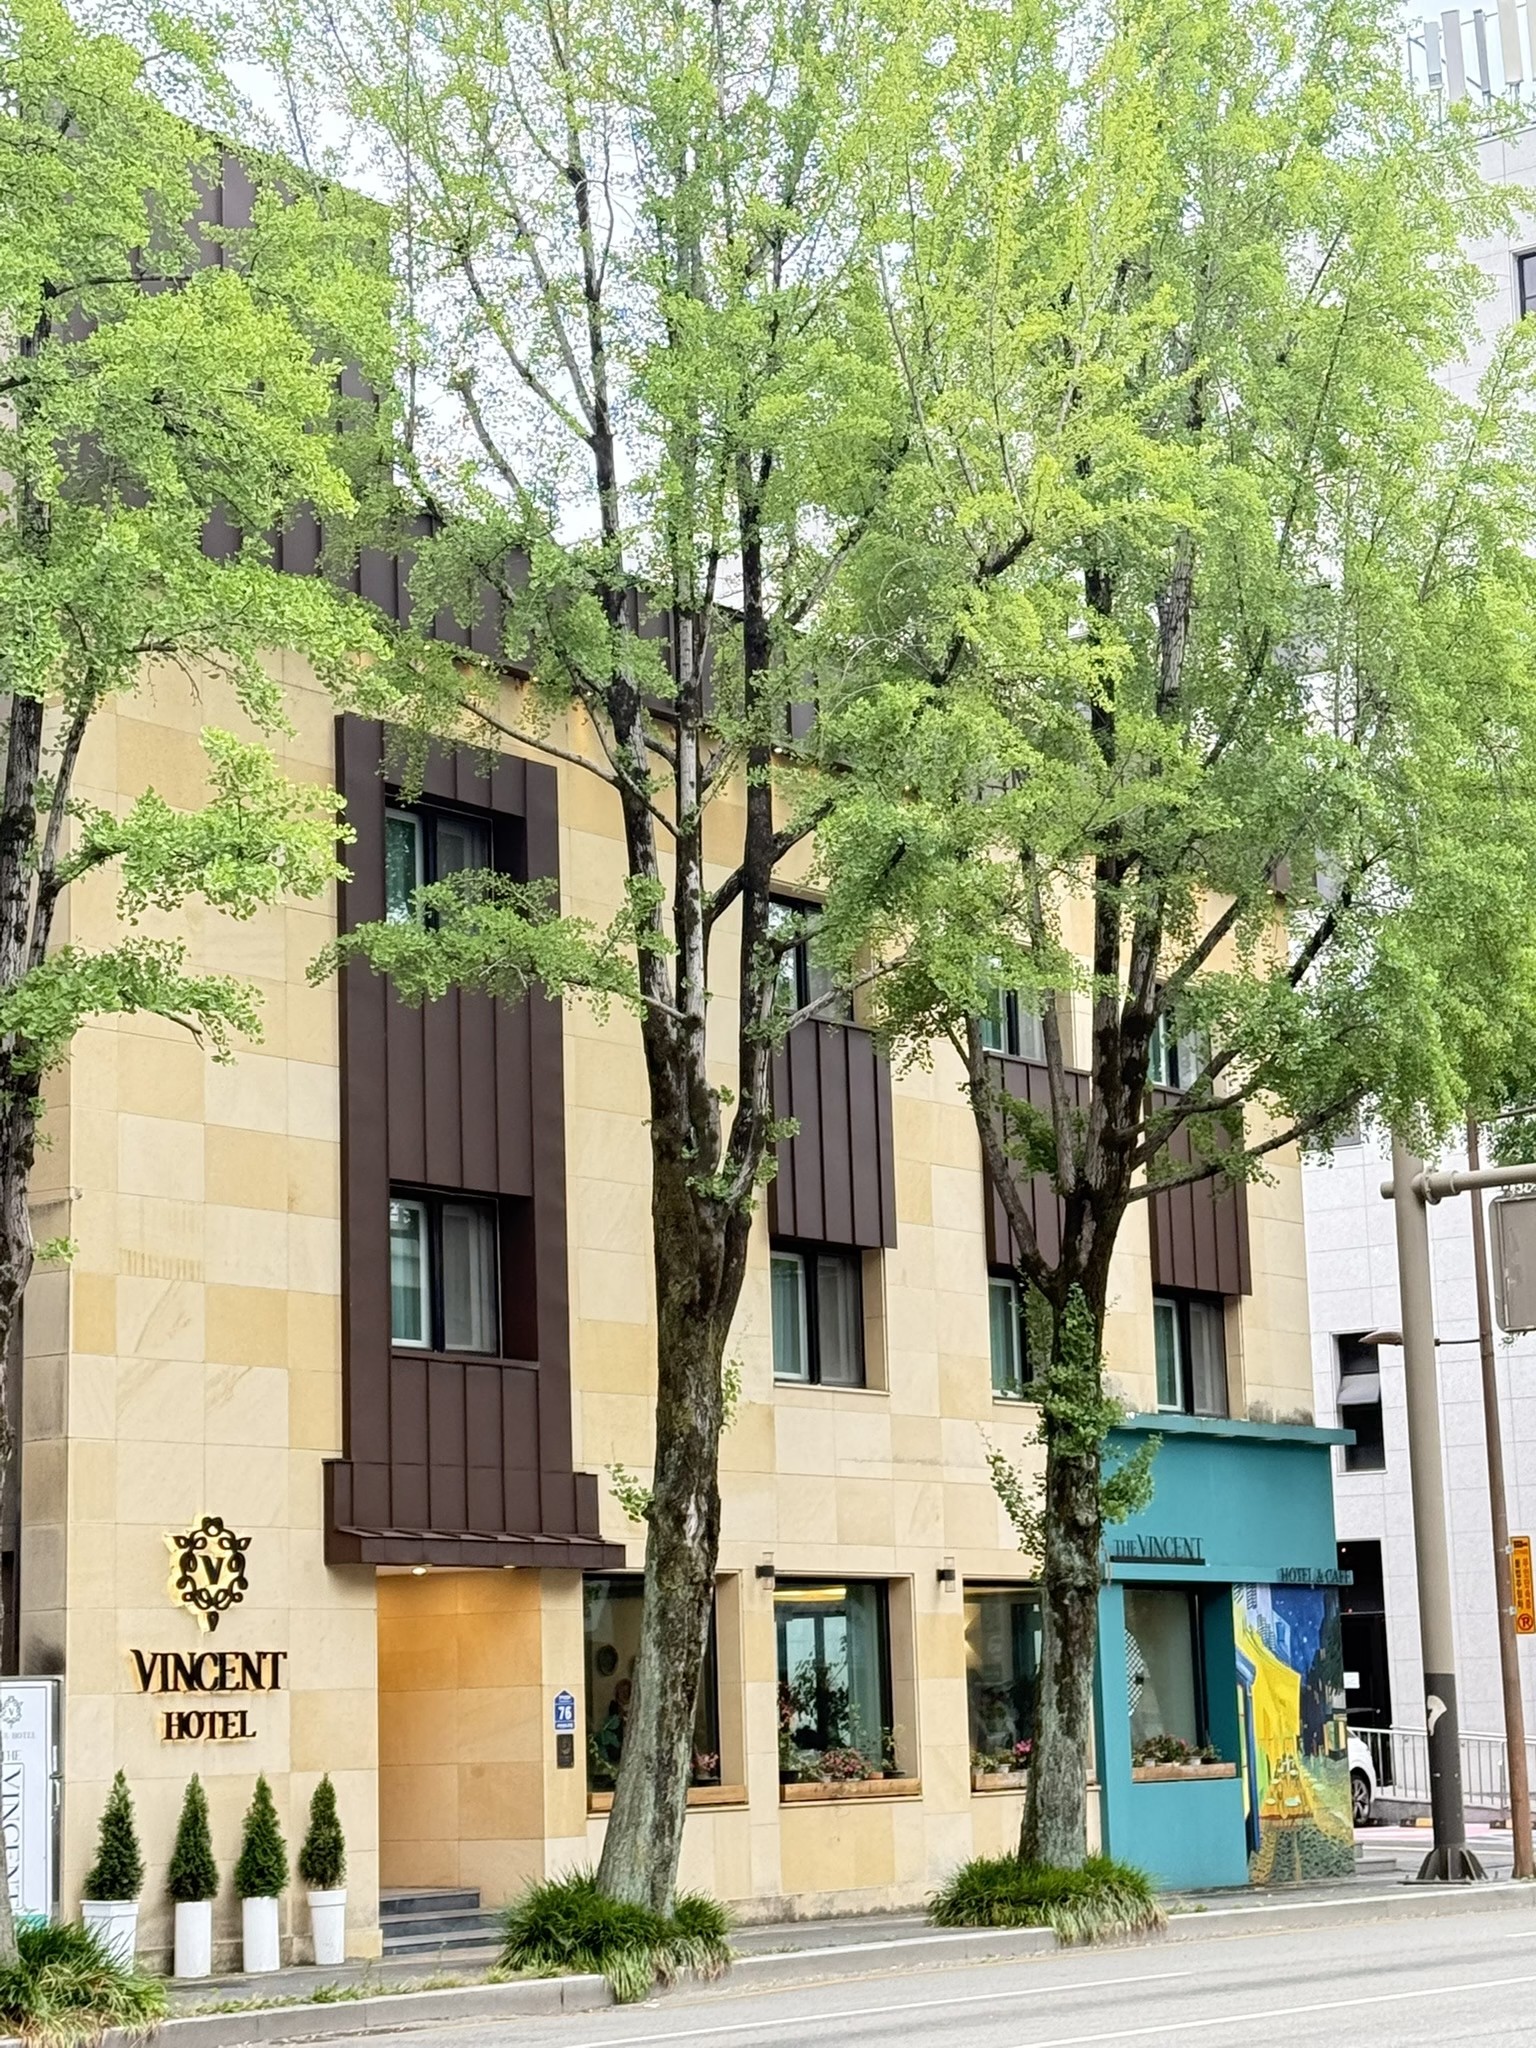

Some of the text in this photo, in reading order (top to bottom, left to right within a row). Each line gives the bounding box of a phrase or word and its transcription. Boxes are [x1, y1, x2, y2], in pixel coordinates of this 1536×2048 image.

[1114, 1533, 1204, 1558] THE VINCENT
[201, 1555, 226, 1586] V
[1280, 1567, 1311, 1582] HOTEL
[130, 1649, 287, 1692] VINCENT
[162, 1710, 256, 1740] HOTEL
[558, 1705, 572, 1720] 76
